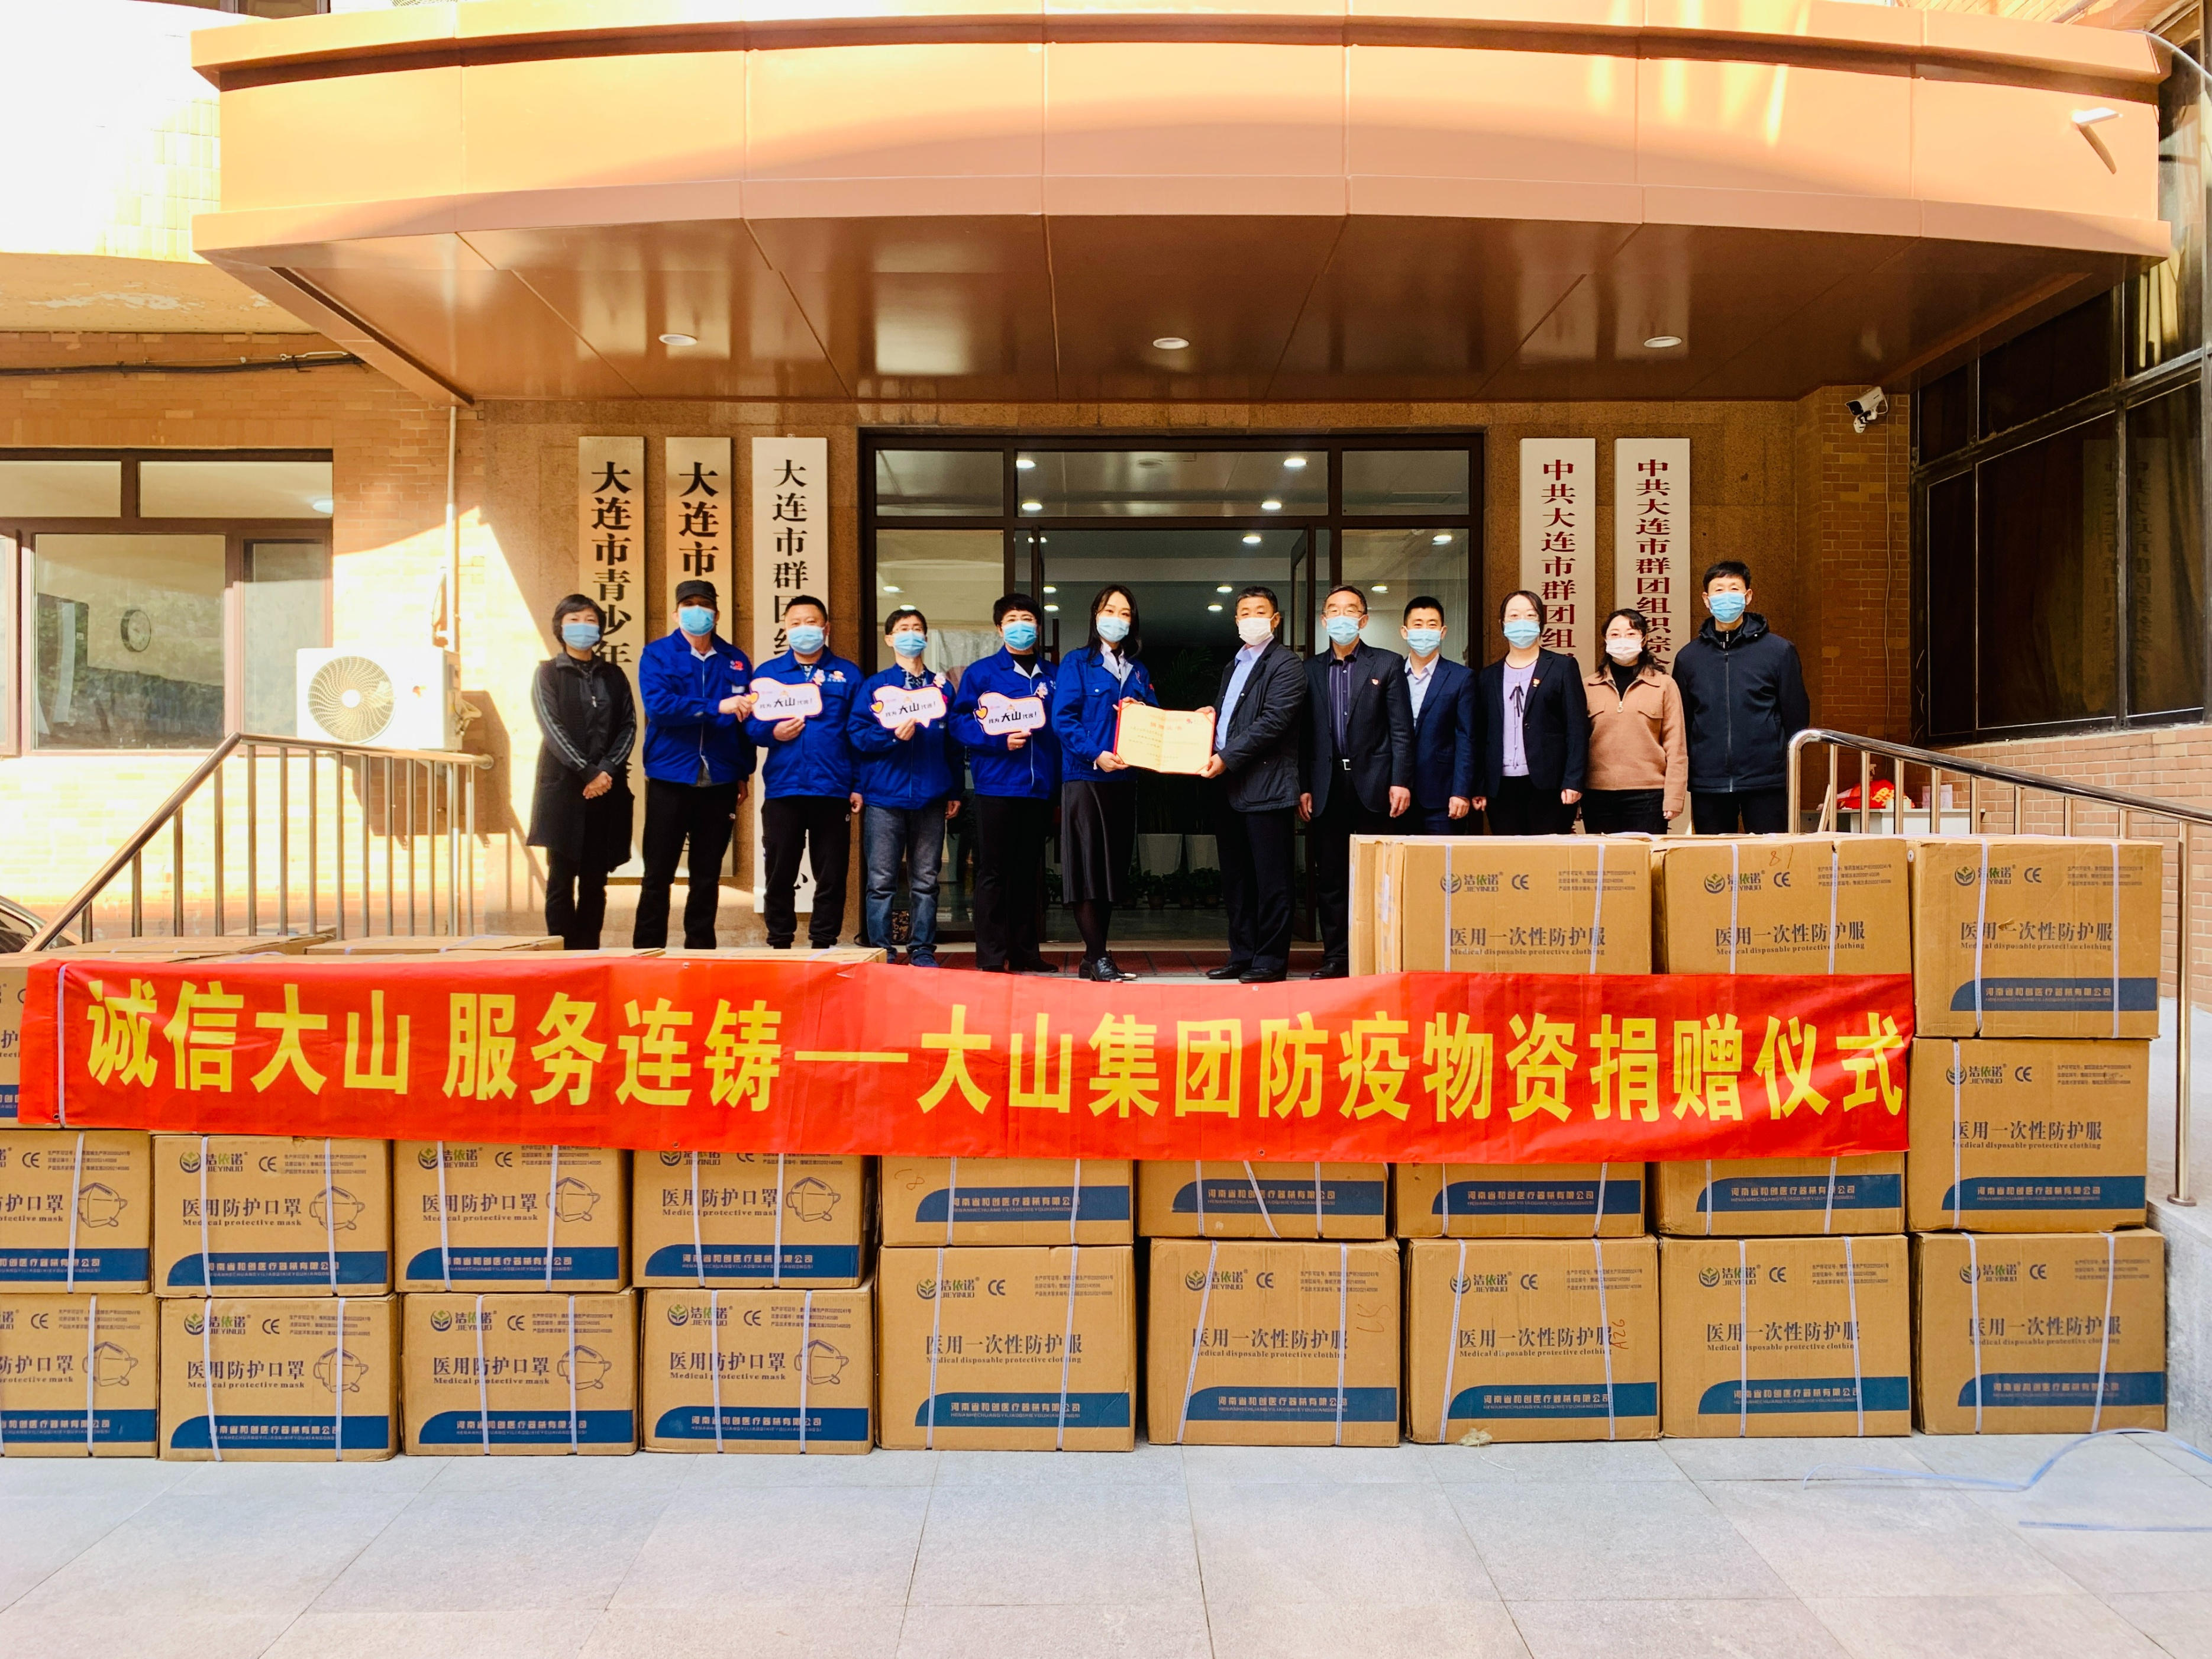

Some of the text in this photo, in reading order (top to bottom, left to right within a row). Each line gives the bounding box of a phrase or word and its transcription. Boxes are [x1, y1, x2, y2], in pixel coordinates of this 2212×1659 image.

[1541, 459, 1577, 657] 中共大连市群团组
[1464, 874, 1499, 885] 洁依诺
[1451, 927, 1605, 947] 医用一次性防护服
[1485, 948, 1526, 957] disposable
[1529, 948, 1569, 957] protective
[1750, 946, 1790, 954] disposable
[87, 978, 410, 1095] 诚信大山
[1969, 1066, 2002, 1077] 洁依诺
[1953, 1121, 2102, 1140] 医用一次性防护服
[1986, 1142, 2027, 1150] disposable
[2029, 1142, 2068, 1150] protective
[1731, 1185, 1855, 1196] 河南省和创医疗器械有公司
[0, 1194, 63, 1213] 护口罩
[422, 1193, 538, 1213] 医用防护口罩
[954, 1196, 1080, 1207] 河南省和创医疗器械有限公
[183, 1198, 302, 1217] 医用防护口罩
[702, 1209, 753, 1218] protective
[1474, 1274, 1507, 1286] 洁依诺
[926, 1334, 1082, 1355] 医用一次性防护服
[1226, 1351, 1269, 1359] disposable
[1271, 1351, 1312, 1360] protective
[1538, 1349, 1578, 1358] protective
[434, 1357, 550, 1376] 医用防护口罩
[670, 1352, 786, 1371] 医用防护口罩
[1005, 1357, 1047, 1365] protective
[188, 1360, 305, 1380] 医用防护口罩
[229, 1381, 279, 1389] protective
